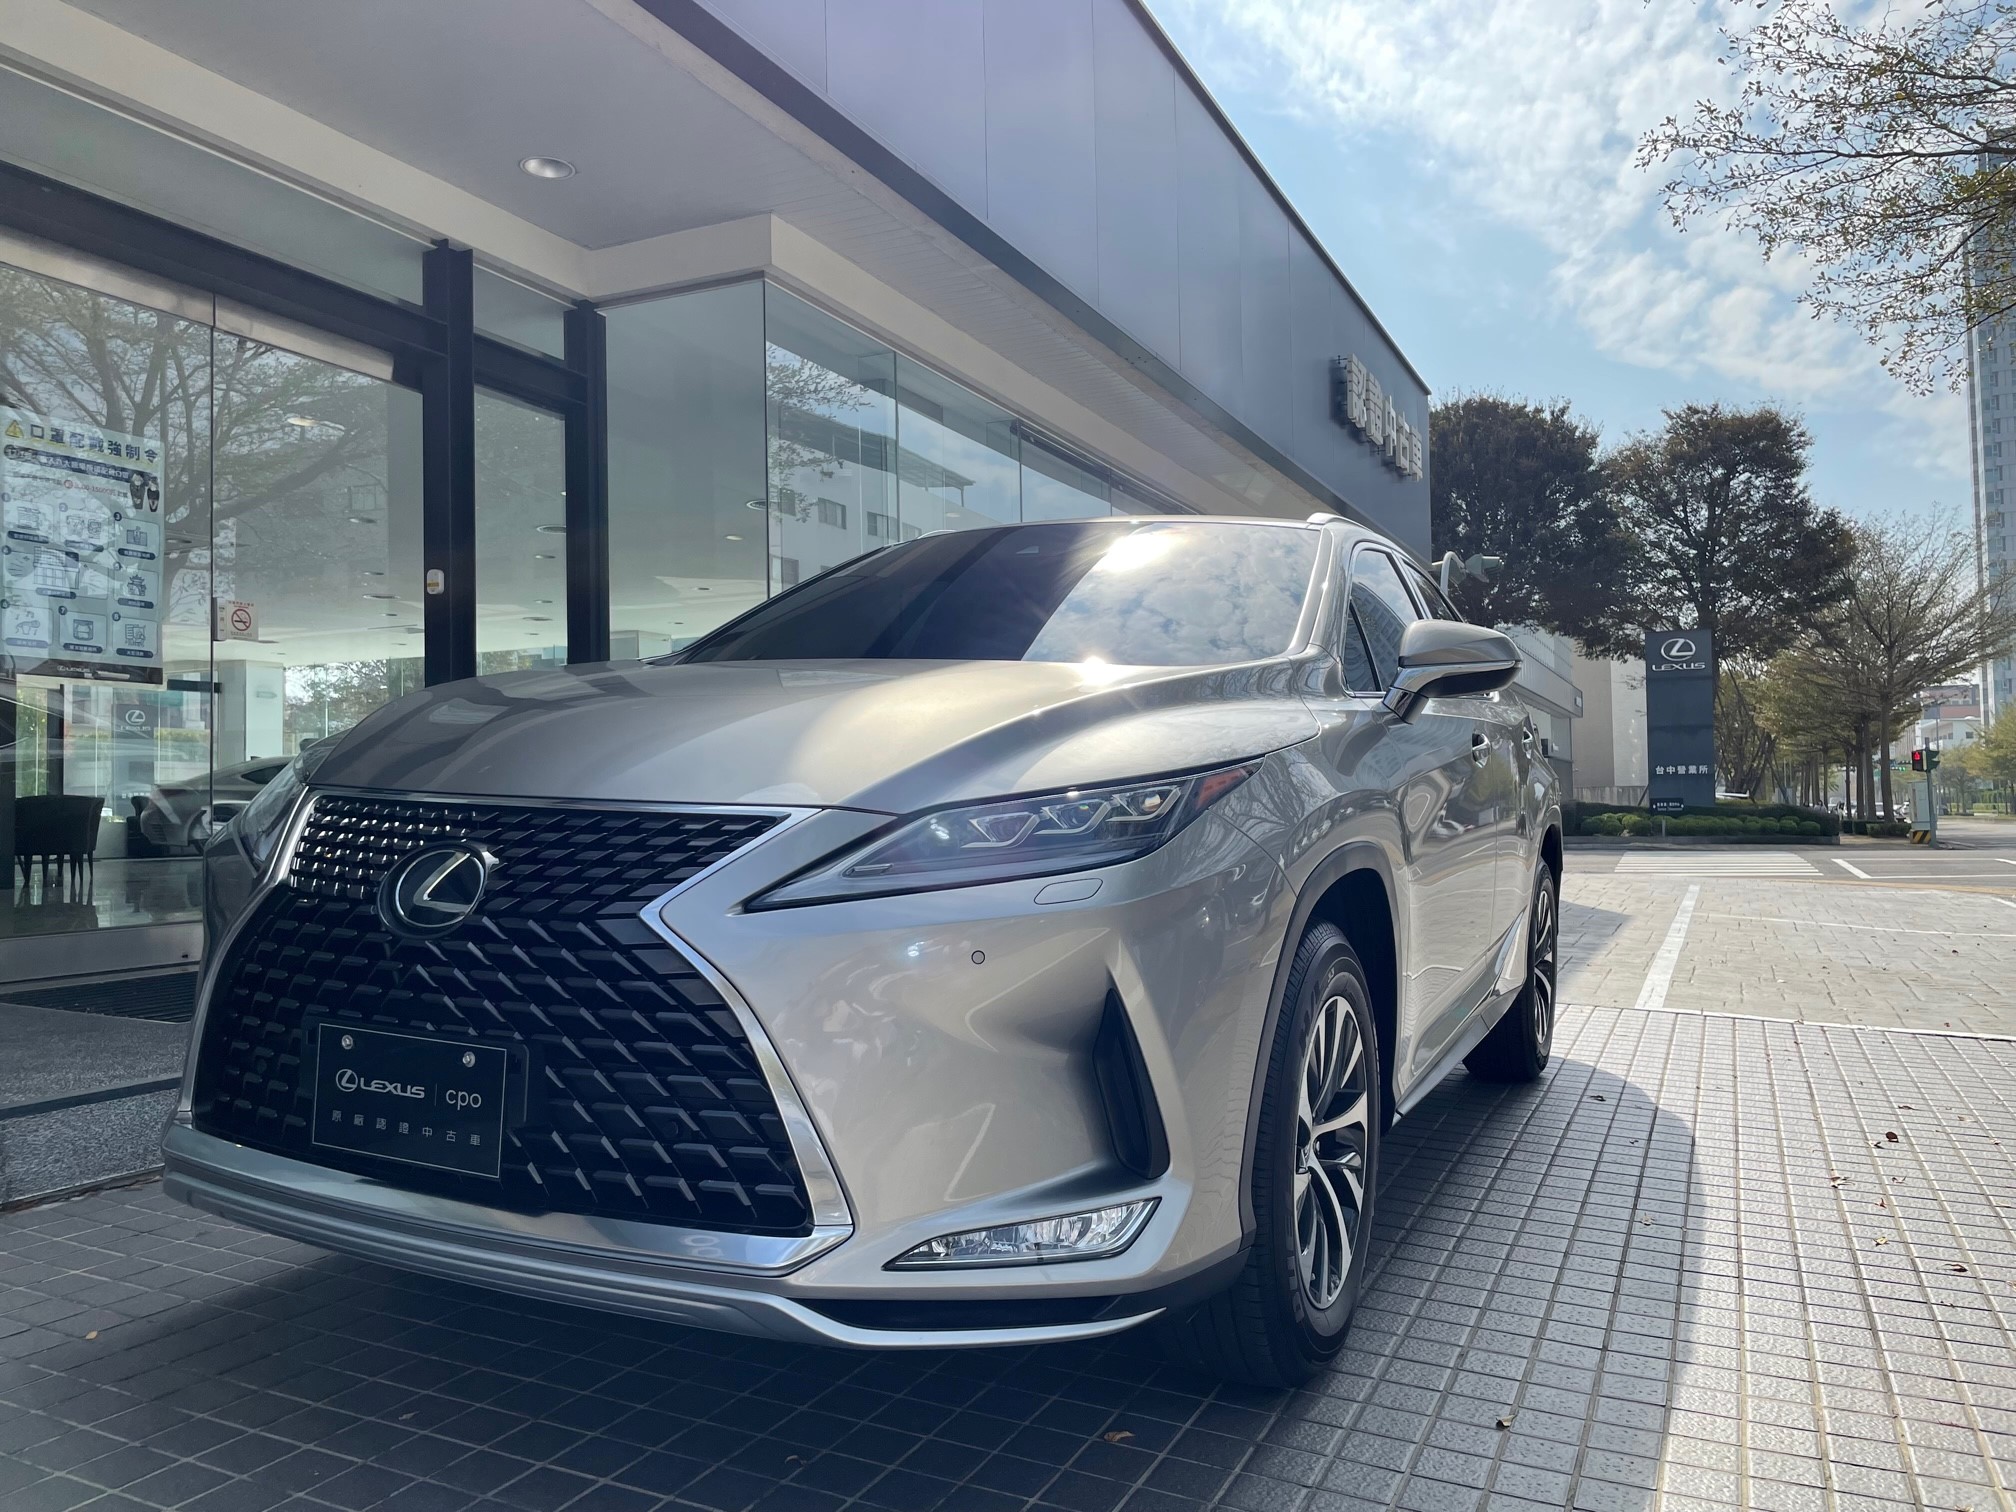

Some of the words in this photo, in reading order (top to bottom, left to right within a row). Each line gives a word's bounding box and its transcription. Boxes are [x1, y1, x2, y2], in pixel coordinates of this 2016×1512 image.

[1346, 352, 1423, 482] 認證中古車
[1652, 662, 1706, 672] LEXUS
[1655, 765, 1709, 775] 台中營業所
[360, 1077, 425, 1099] LEXUS
[445, 1089, 482, 1110] cpo
[331, 1109, 481, 1146] 原廠認證中古車
